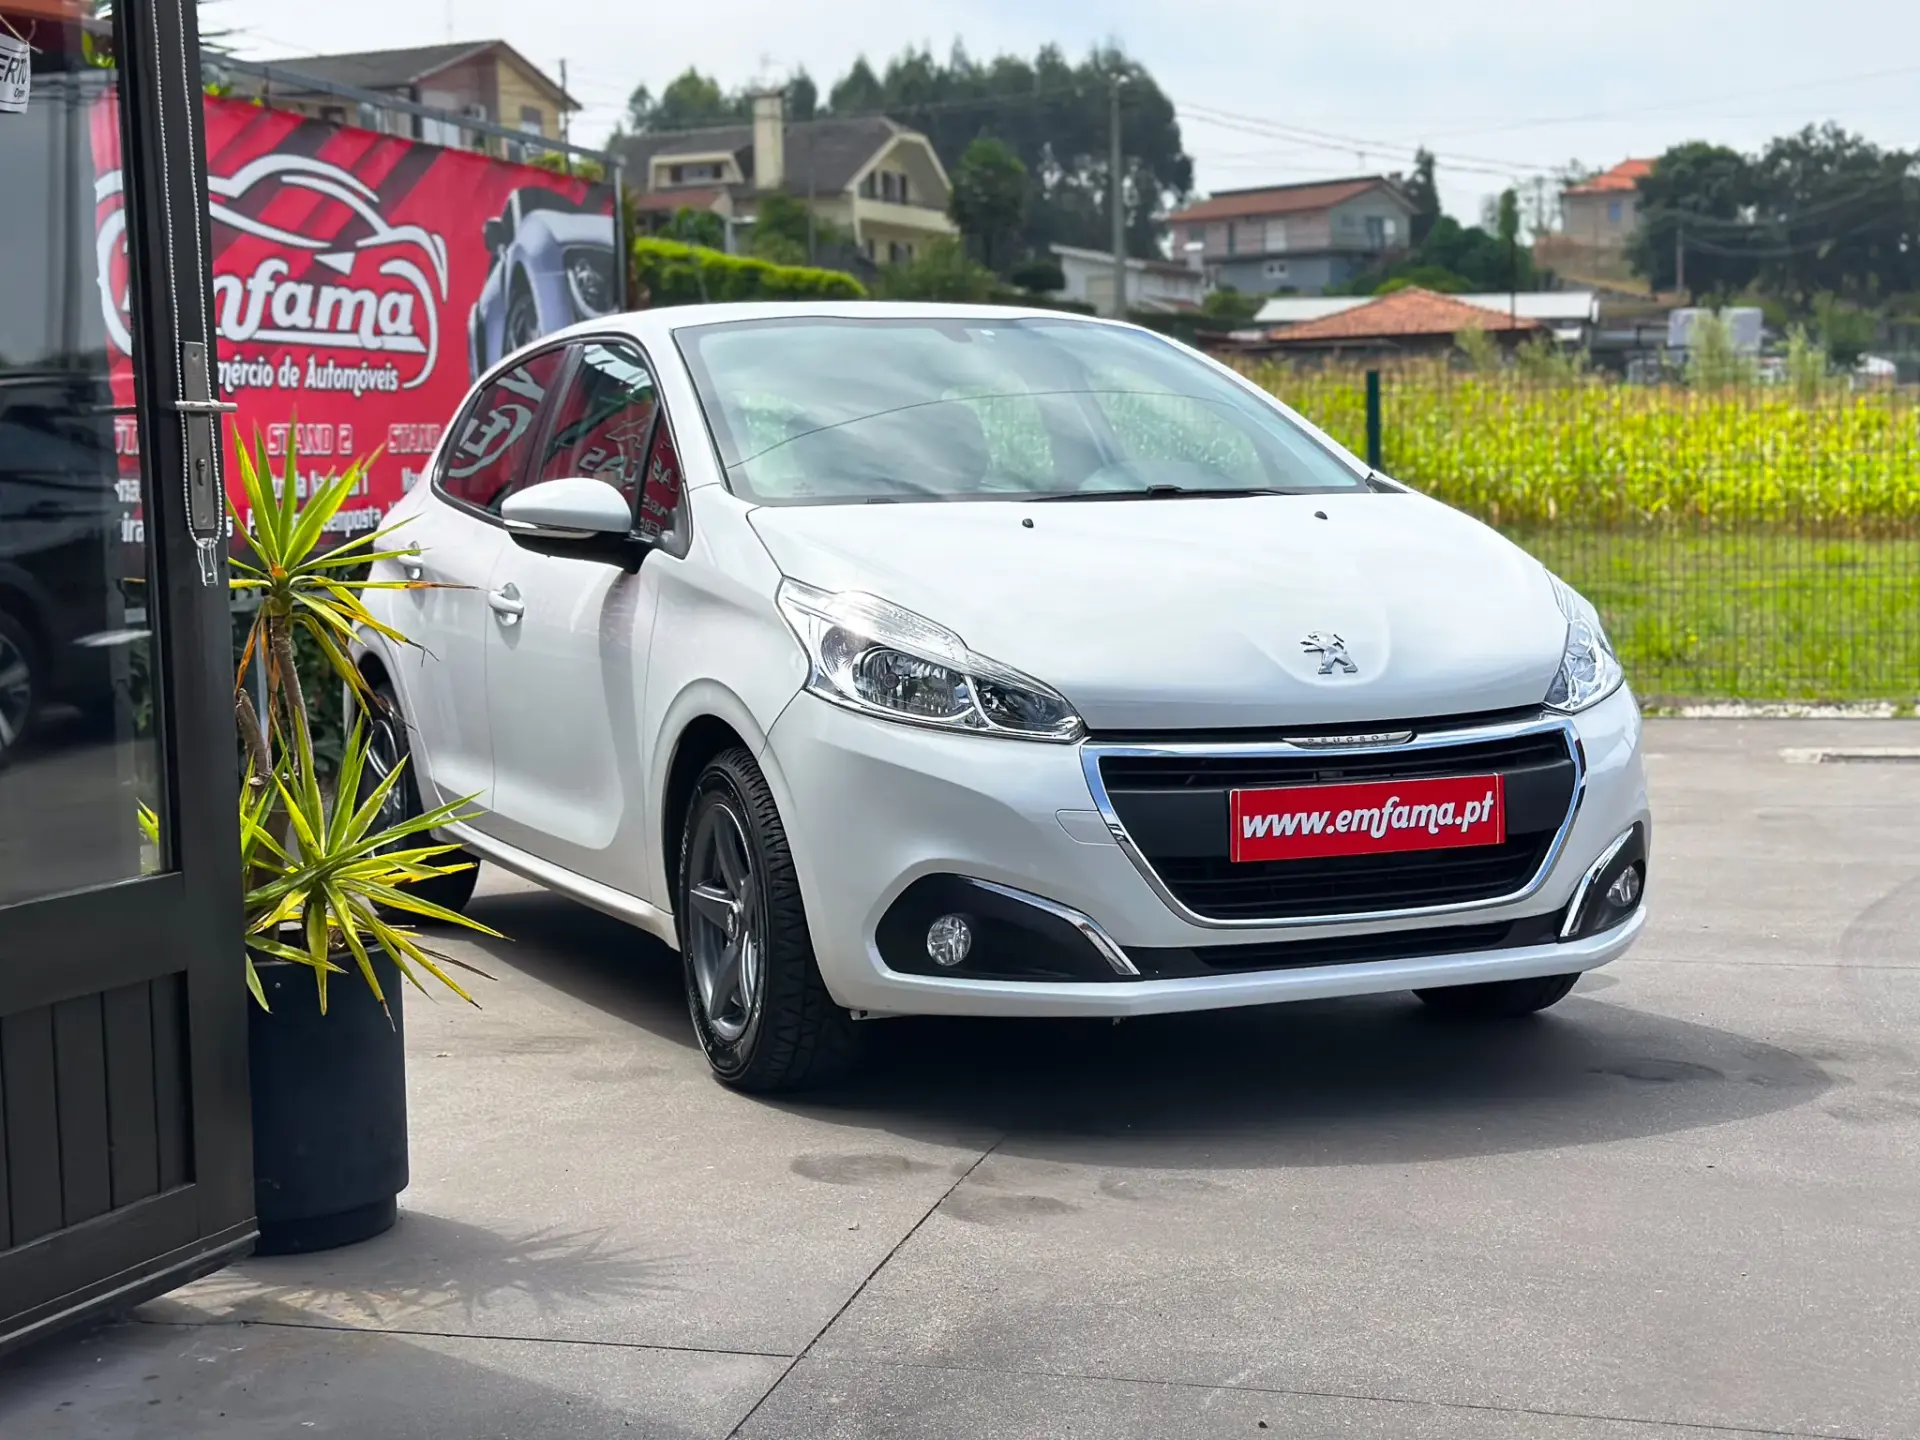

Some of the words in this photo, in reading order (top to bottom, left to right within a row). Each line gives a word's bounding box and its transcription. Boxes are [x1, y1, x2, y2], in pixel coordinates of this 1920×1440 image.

[213, 257, 414, 349] fama
[217, 354, 274, 393] mércio
[278, 354, 299, 388] de
[304, 352, 399, 397] Automóveis
[267, 423, 334, 455] STAND
[339, 423, 353, 455] 2
[1307, 733, 1391, 745] PEUGEOT
[1242, 790, 1494, 839] www.emfama.pt
